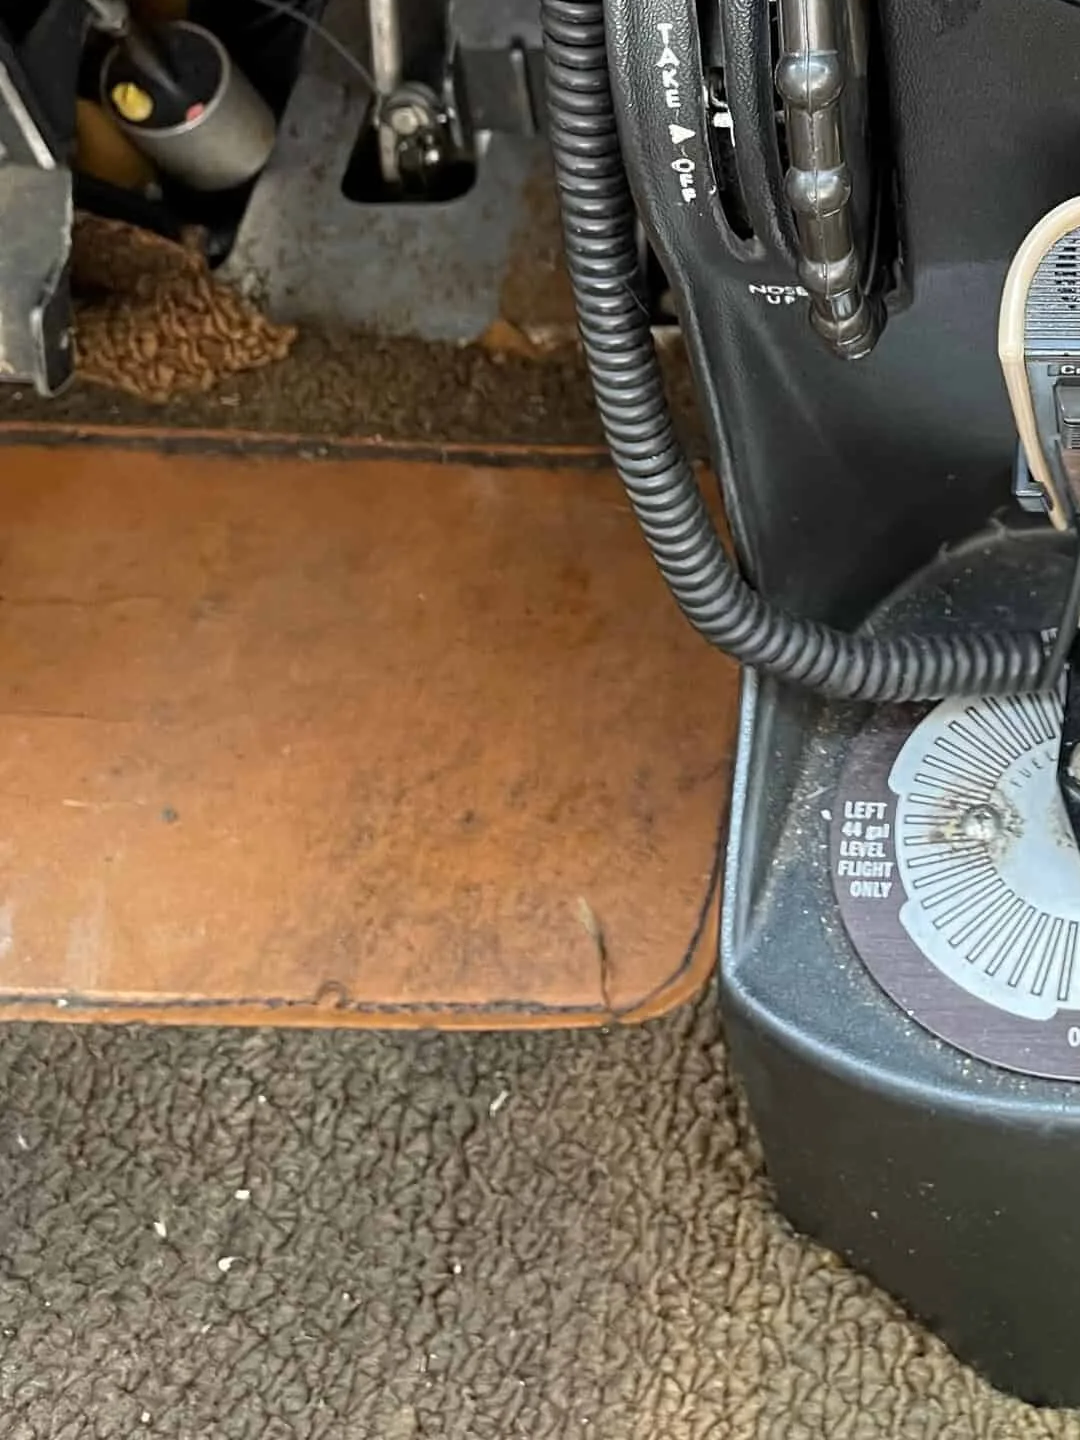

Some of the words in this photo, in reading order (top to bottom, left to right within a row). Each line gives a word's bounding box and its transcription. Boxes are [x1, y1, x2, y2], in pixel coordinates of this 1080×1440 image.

[656, 22, 682, 109] TAKE
[844, 800, 888, 820] LEFT
[840, 840, 886, 858] LEVEL
[838, 860, 894, 878] FLIGHT
[849, 880, 893, 898] ONLY
